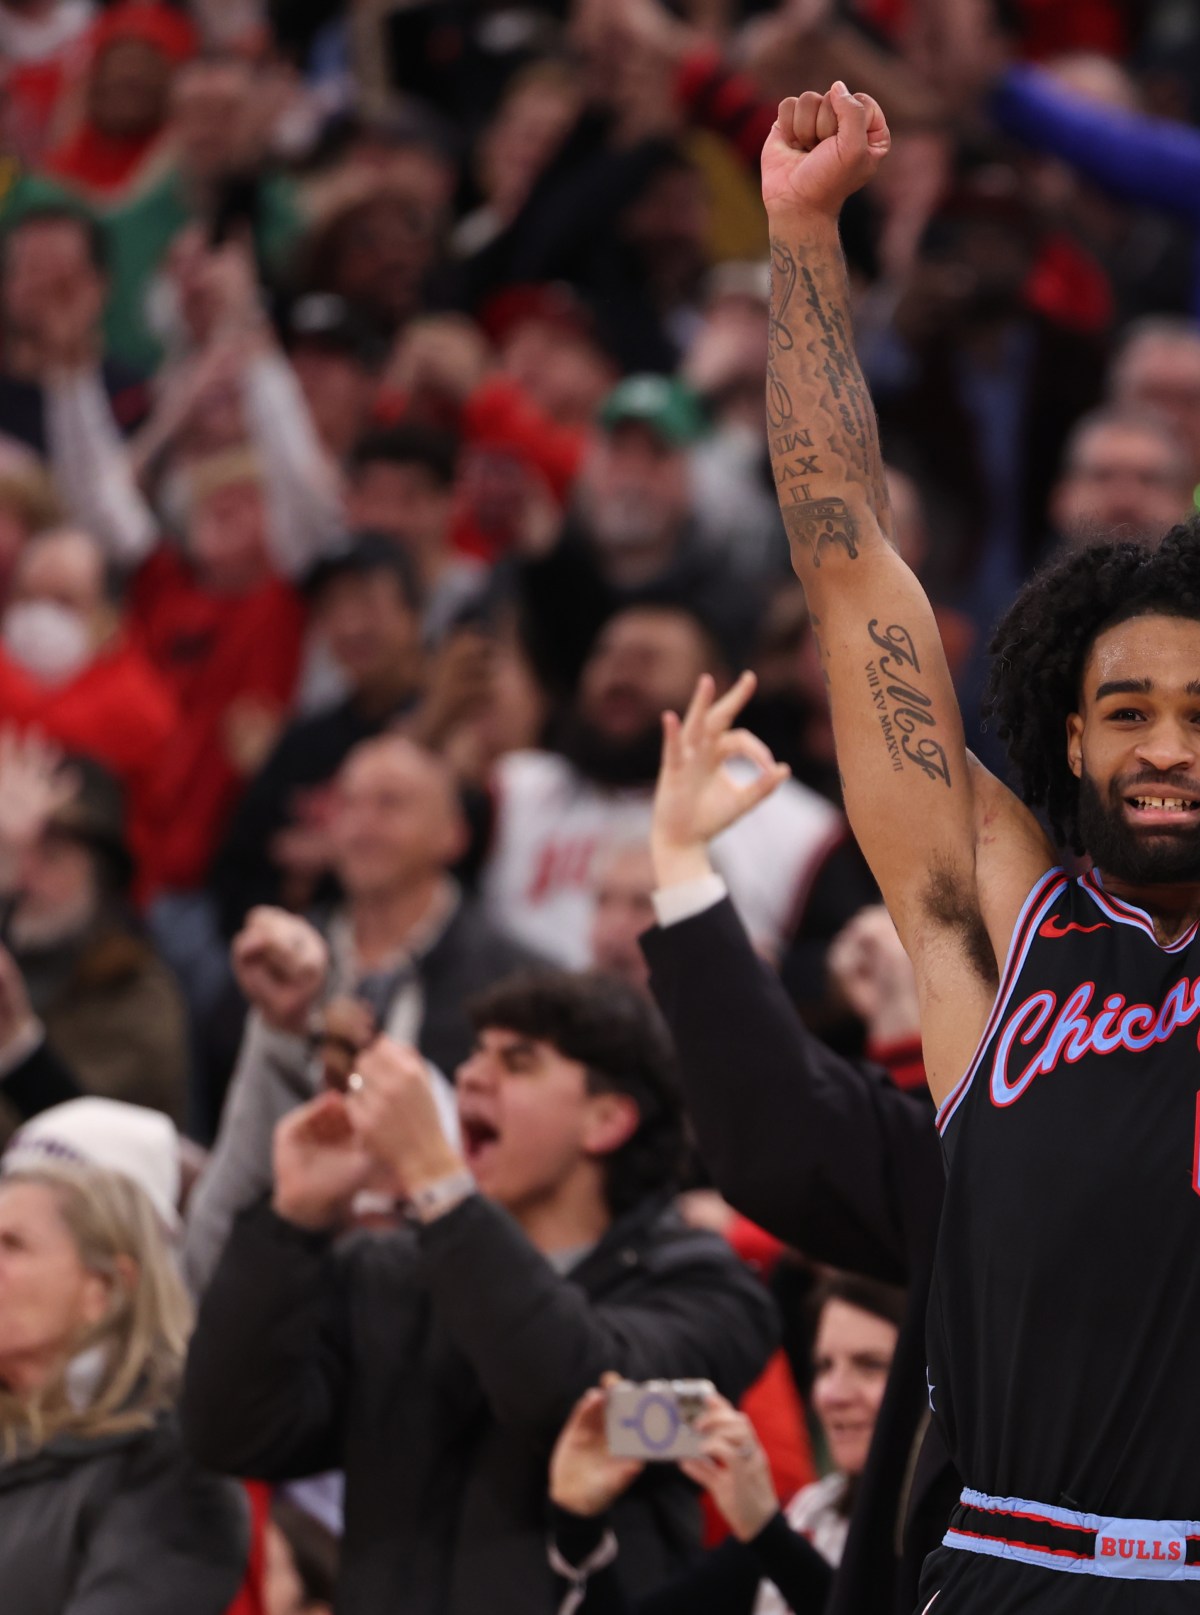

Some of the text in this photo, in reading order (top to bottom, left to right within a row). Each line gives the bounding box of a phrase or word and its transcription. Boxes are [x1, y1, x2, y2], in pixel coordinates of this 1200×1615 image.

[864, 659, 905, 773] VIII XV MMXVII
[1100, 1536, 1182, 1561] BULLS
